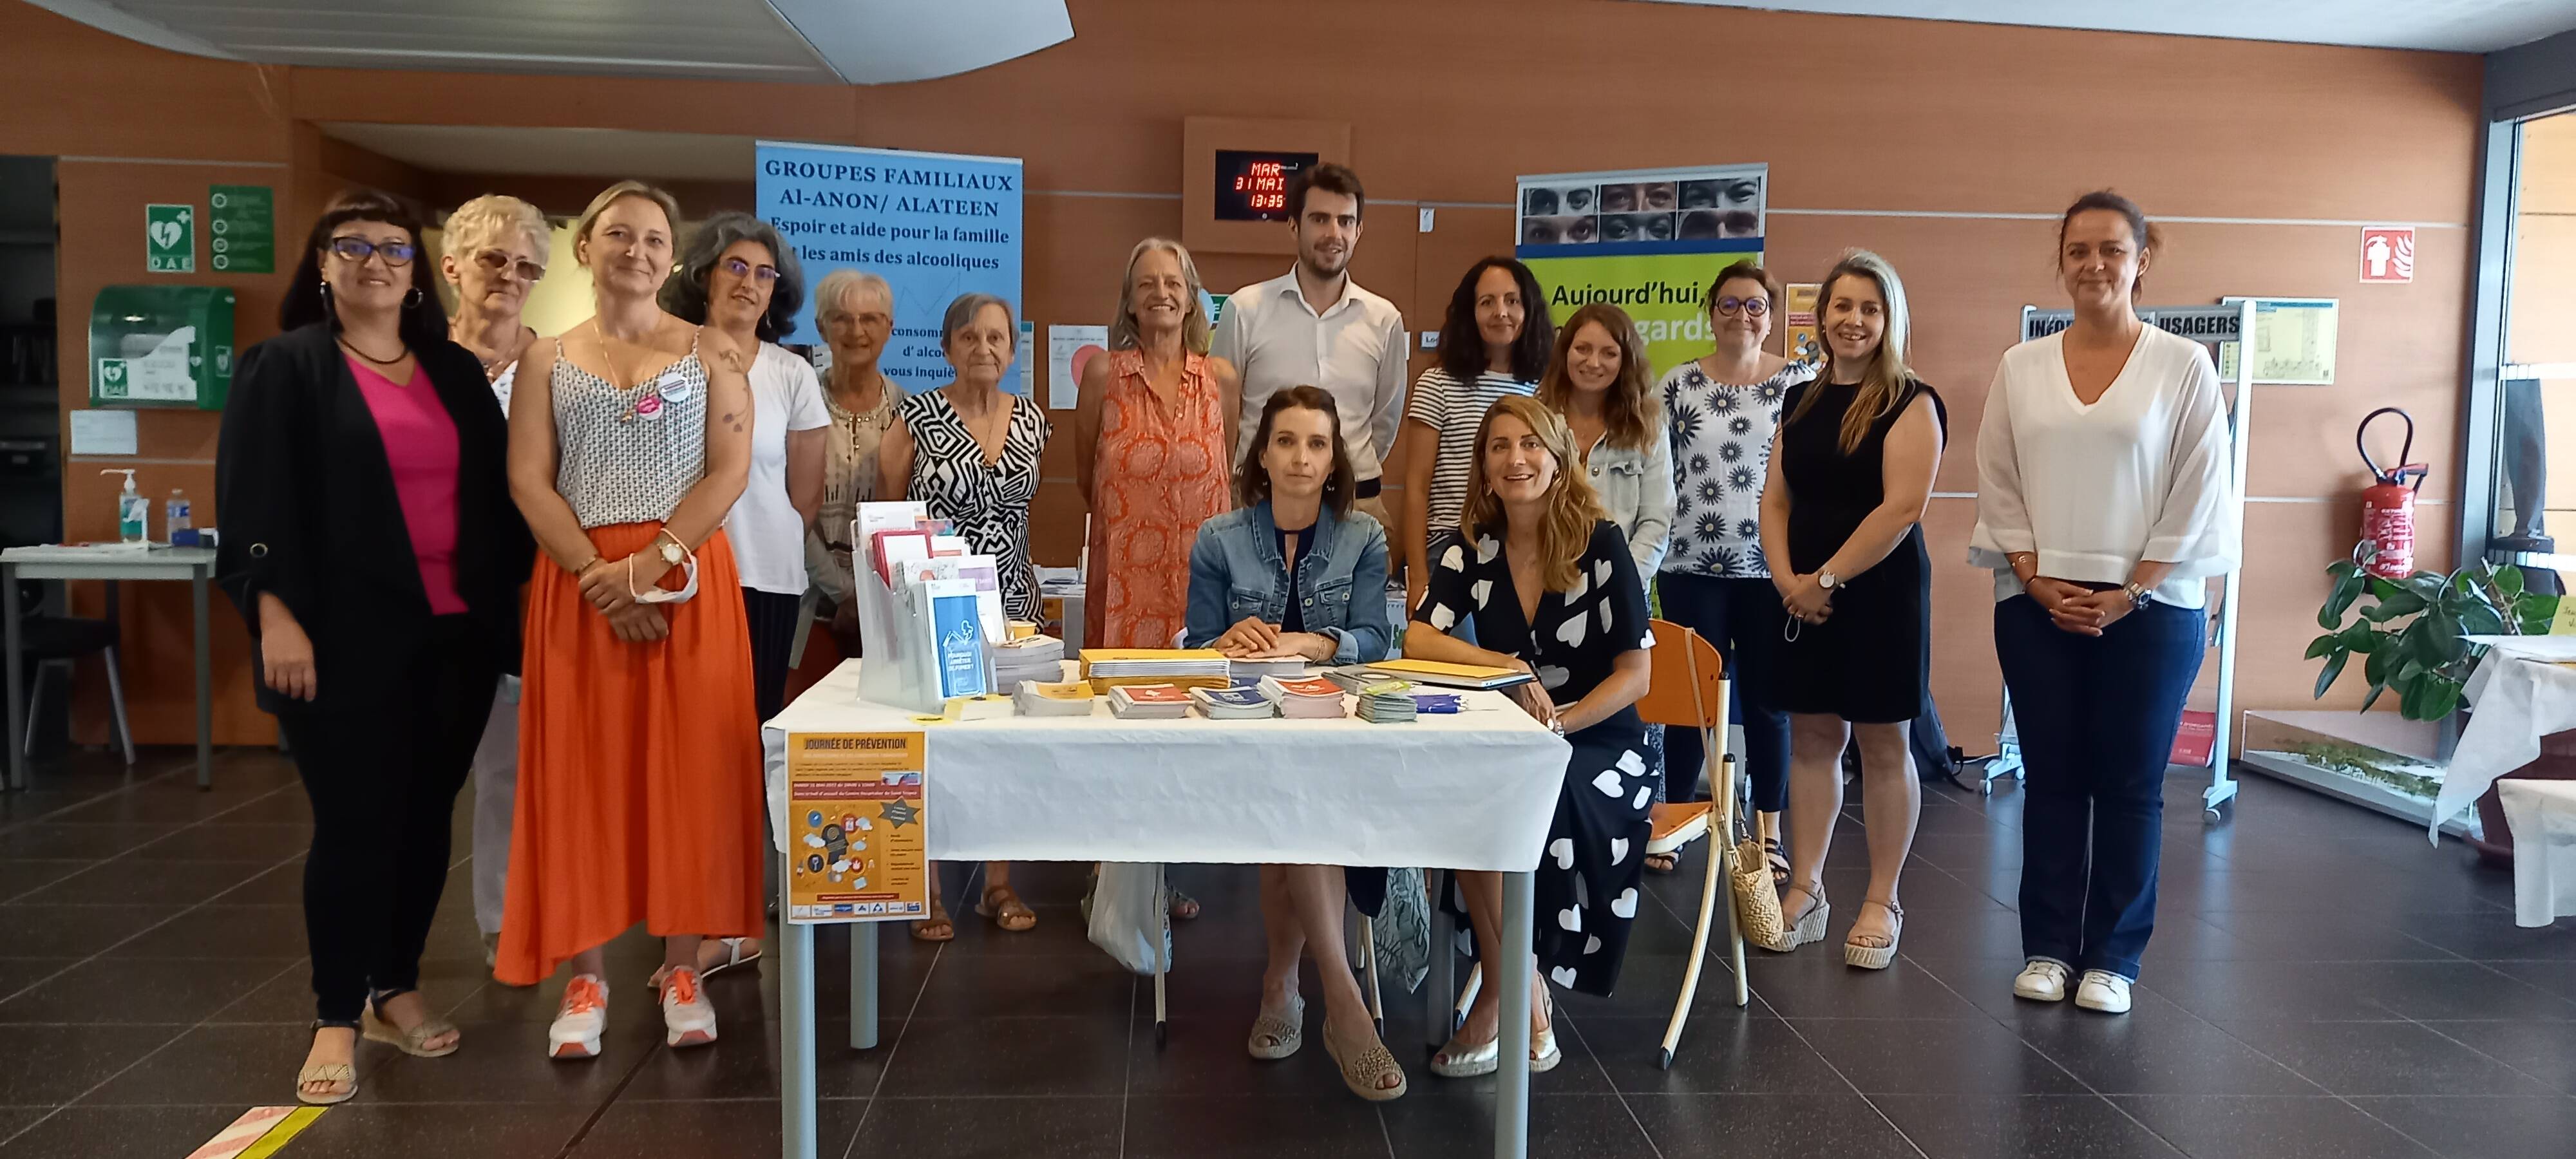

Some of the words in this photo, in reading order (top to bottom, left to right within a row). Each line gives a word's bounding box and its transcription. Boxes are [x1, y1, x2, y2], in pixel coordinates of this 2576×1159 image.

[765, 160, 876, 182] GROUPES
[884, 168, 1012, 191] FAMILIAUX
[1251, 162, 1280, 176] MAR
[1235, 177, 1252, 191] 31
[1256, 178, 1284, 191] MAI
[779, 189, 889, 214] Al-ANON/
[896, 196, 999, 217] ALATEEN
[1251, 194, 1283, 208] 13:35
[771, 216, 826, 236] Espoir
[830, 222, 847, 234] et
[850, 221, 886, 236] aide
[891, 226, 931, 241] pour
[934, 225, 948, 241] la
[953, 227, 1009, 243] famille
[149, 257, 192, 270] DAE
[802, 245, 826, 261] les
[830, 248, 869, 263] amis
[875, 249, 902, 264] des
[907, 251, 999, 272] alcooliques
[1551, 281, 1706, 308] Aujourd'hui,
[1634, 312, 1716, 346] gards
[2159, 316, 2240, 335] USAGERS
[884, 368, 913, 377] vous
[805, 737, 840, 750] JOURNÉE
[842, 739, 853, 749] DE
[855, 737, 906, 749] PRÉVENTION
